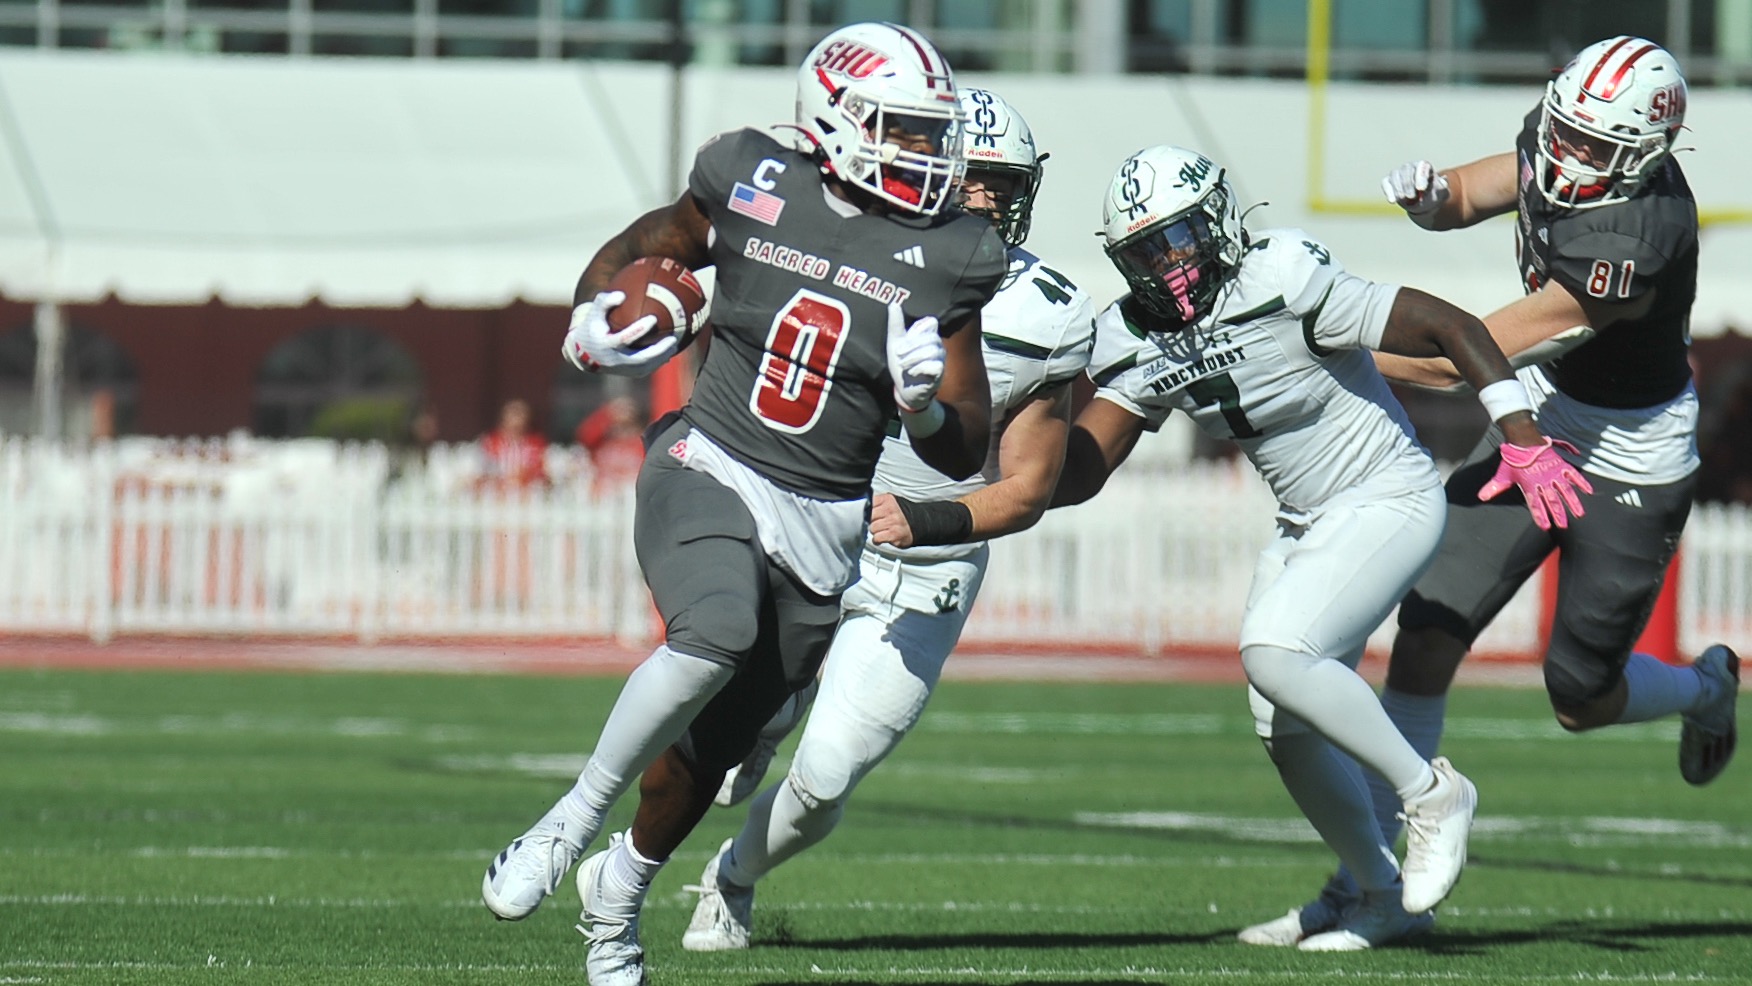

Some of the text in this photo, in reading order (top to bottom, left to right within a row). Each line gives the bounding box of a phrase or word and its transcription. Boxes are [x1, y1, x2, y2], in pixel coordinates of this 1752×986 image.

[813, 40, 891, 80] SHU
[752, 158, 787, 191] C
[744, 237, 911, 304] SACRED HEART
[1031, 265, 1078, 306] 44
[1586, 260, 1635, 298] 81
[749, 287, 851, 435] 0
[1149, 346, 1247, 396] MERCYHURST
[1184, 370, 1264, 439] 7
